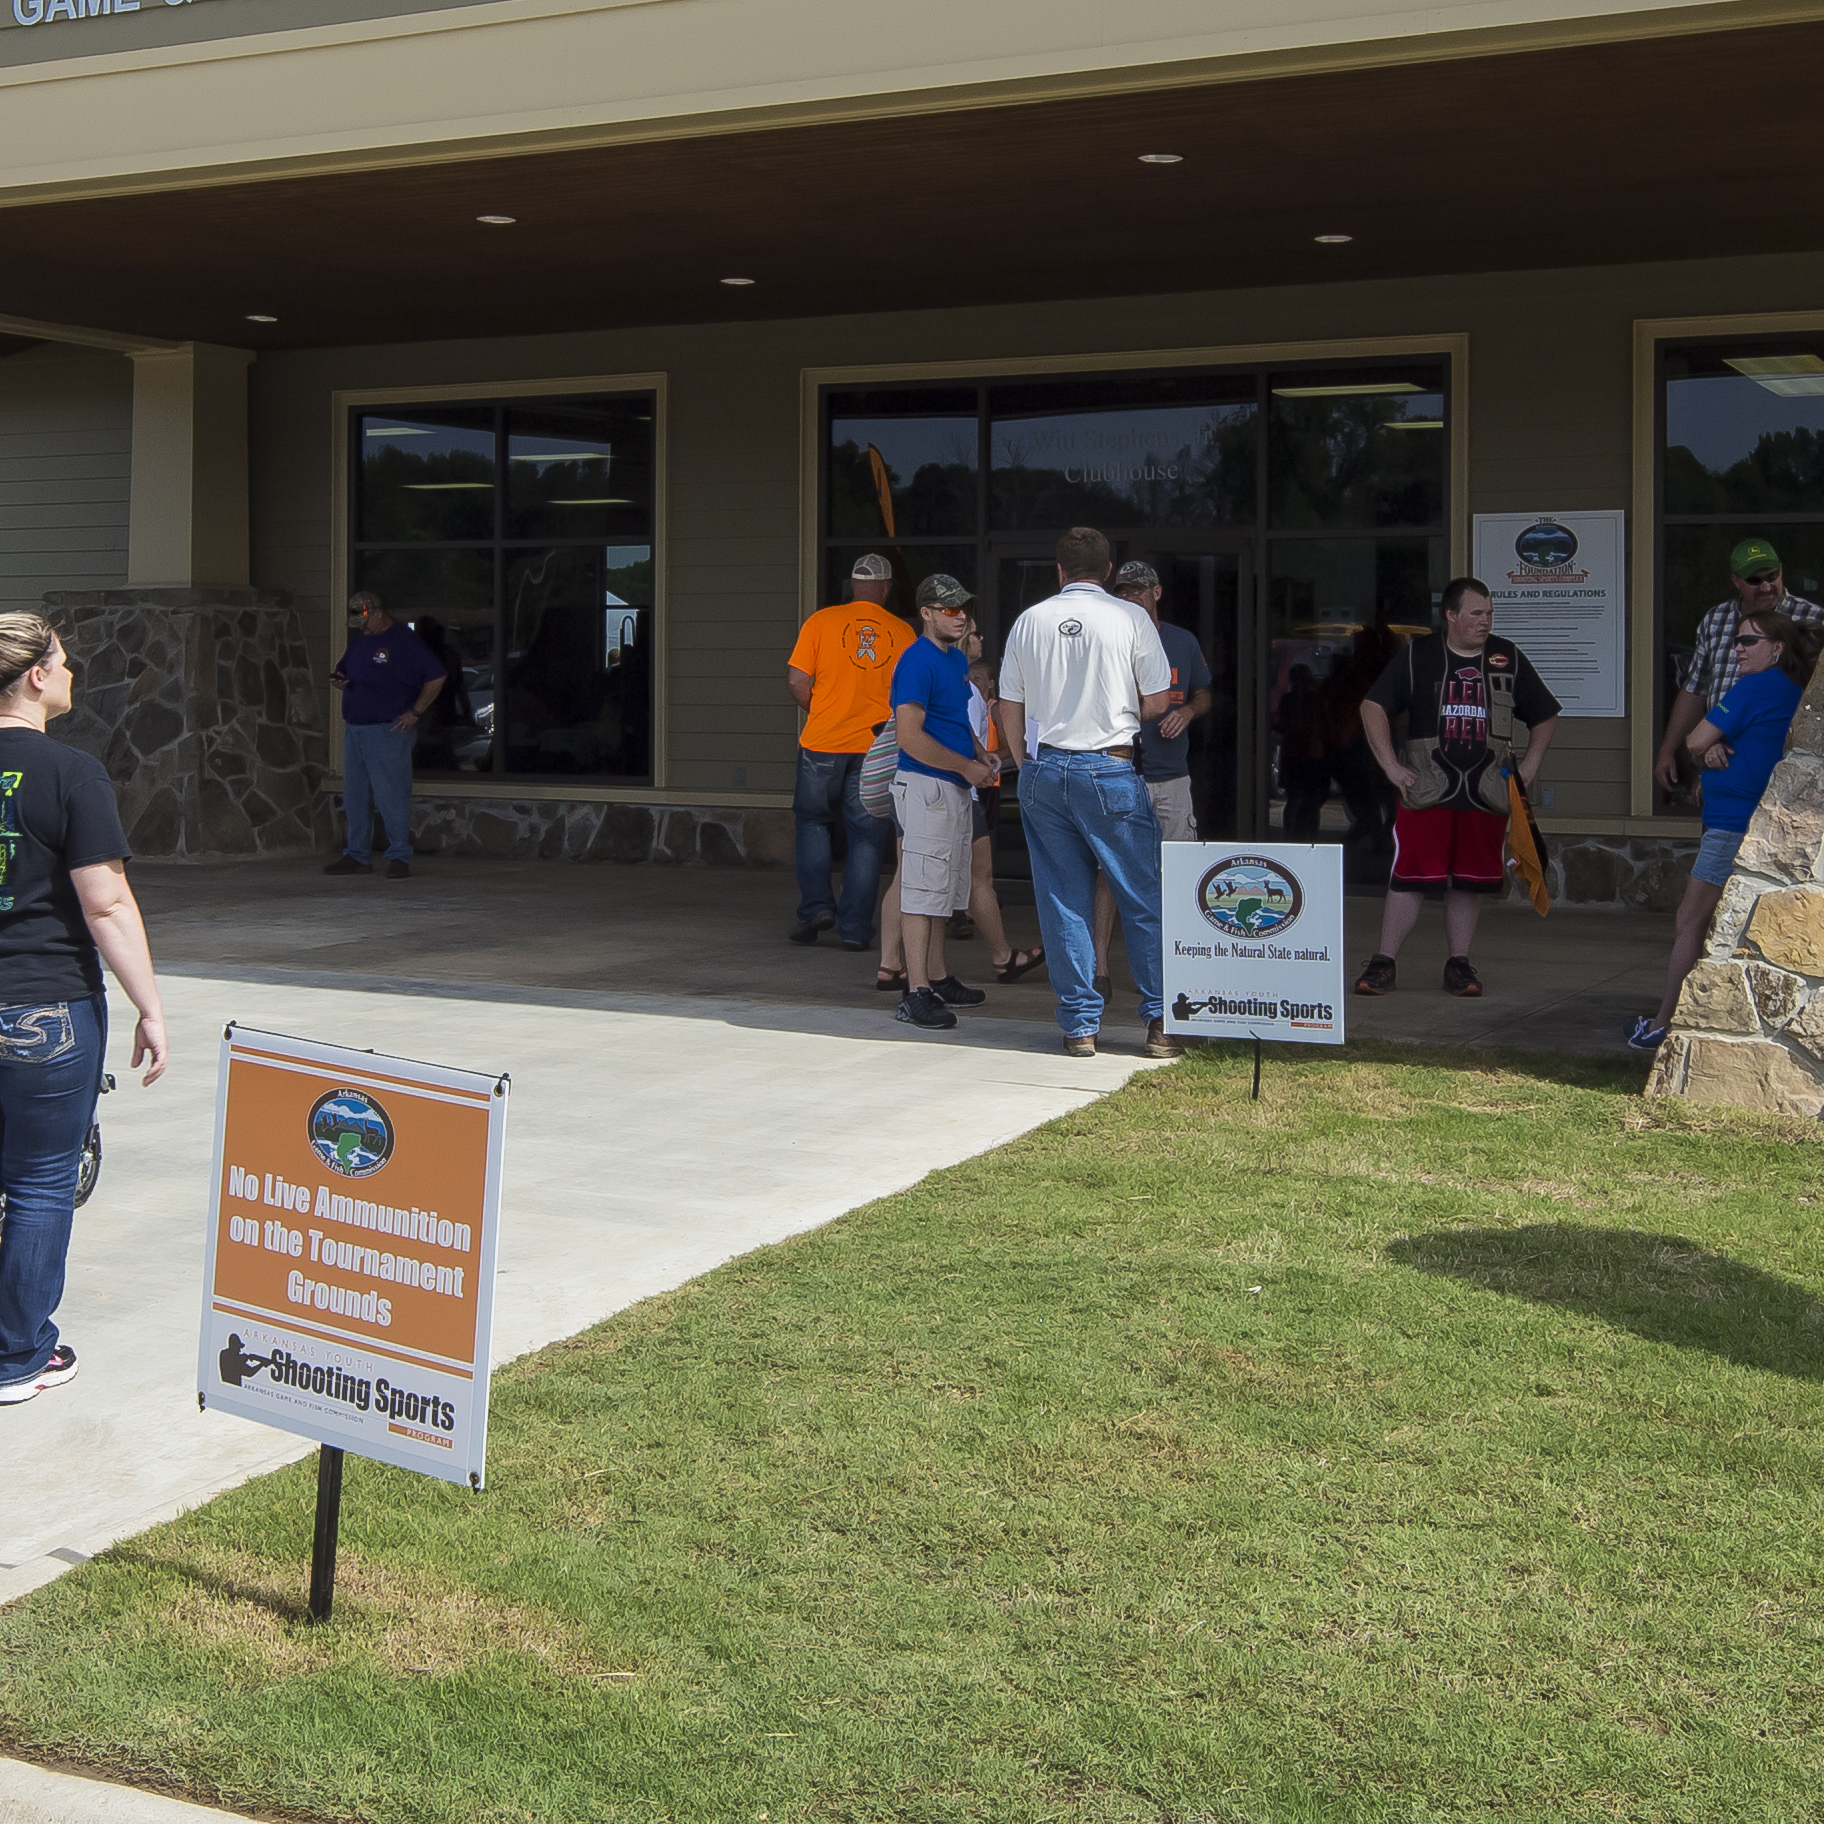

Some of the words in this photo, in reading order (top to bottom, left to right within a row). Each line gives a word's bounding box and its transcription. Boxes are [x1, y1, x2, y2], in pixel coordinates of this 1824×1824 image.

[1519, 560, 1574, 575] FOUNDATION
[1490, 590, 1518, 598] RULES
[1520, 590, 1540, 598] AND
[1542, 589, 1606, 598] REGULATIONS
[1230, 857, 1268, 868] Arkansas
[1204, 909, 1224, 929] Game
[1230, 927, 1246, 937] Fish
[1174, 940, 1212, 959] Keeping
[1214, 942, 1229, 958] the
[1231, 942, 1266, 959] Natural
[1268, 943, 1292, 960] State
[1294, 945, 1331, 961] natural.
[1187, 988, 1239, 997] ARKANSAS
[1245, 990, 1279, 998] YOUTH
[1208, 995, 1278, 1019] Shooting
[1280, 999, 1333, 1021] Sports
[228, 1164, 259, 1202] No
[263, 1172, 311, 1214] Live
[313, 1185, 472, 1253] Ammunition
[229, 1215, 260, 1247] on
[263, 1219, 304, 1258] the
[308, 1228, 465, 1298] Tournament
[286, 1269, 393, 1327] Grounds
[242, 1328, 316, 1357] ARKANSAS
[325, 1350, 374, 1373] YOUTH
[270, 1348, 372, 1411] Shooting
[374, 1377, 456, 1432] Sports
[243, 1383, 275, 1398] ARKANSAS
[294, 1398, 308, 1408] AND
[308, 1402, 323, 1412] FISH
[323, 1407, 365, 1425] COMMISSION
[406, 1428, 451, 1448] PROGRAM
